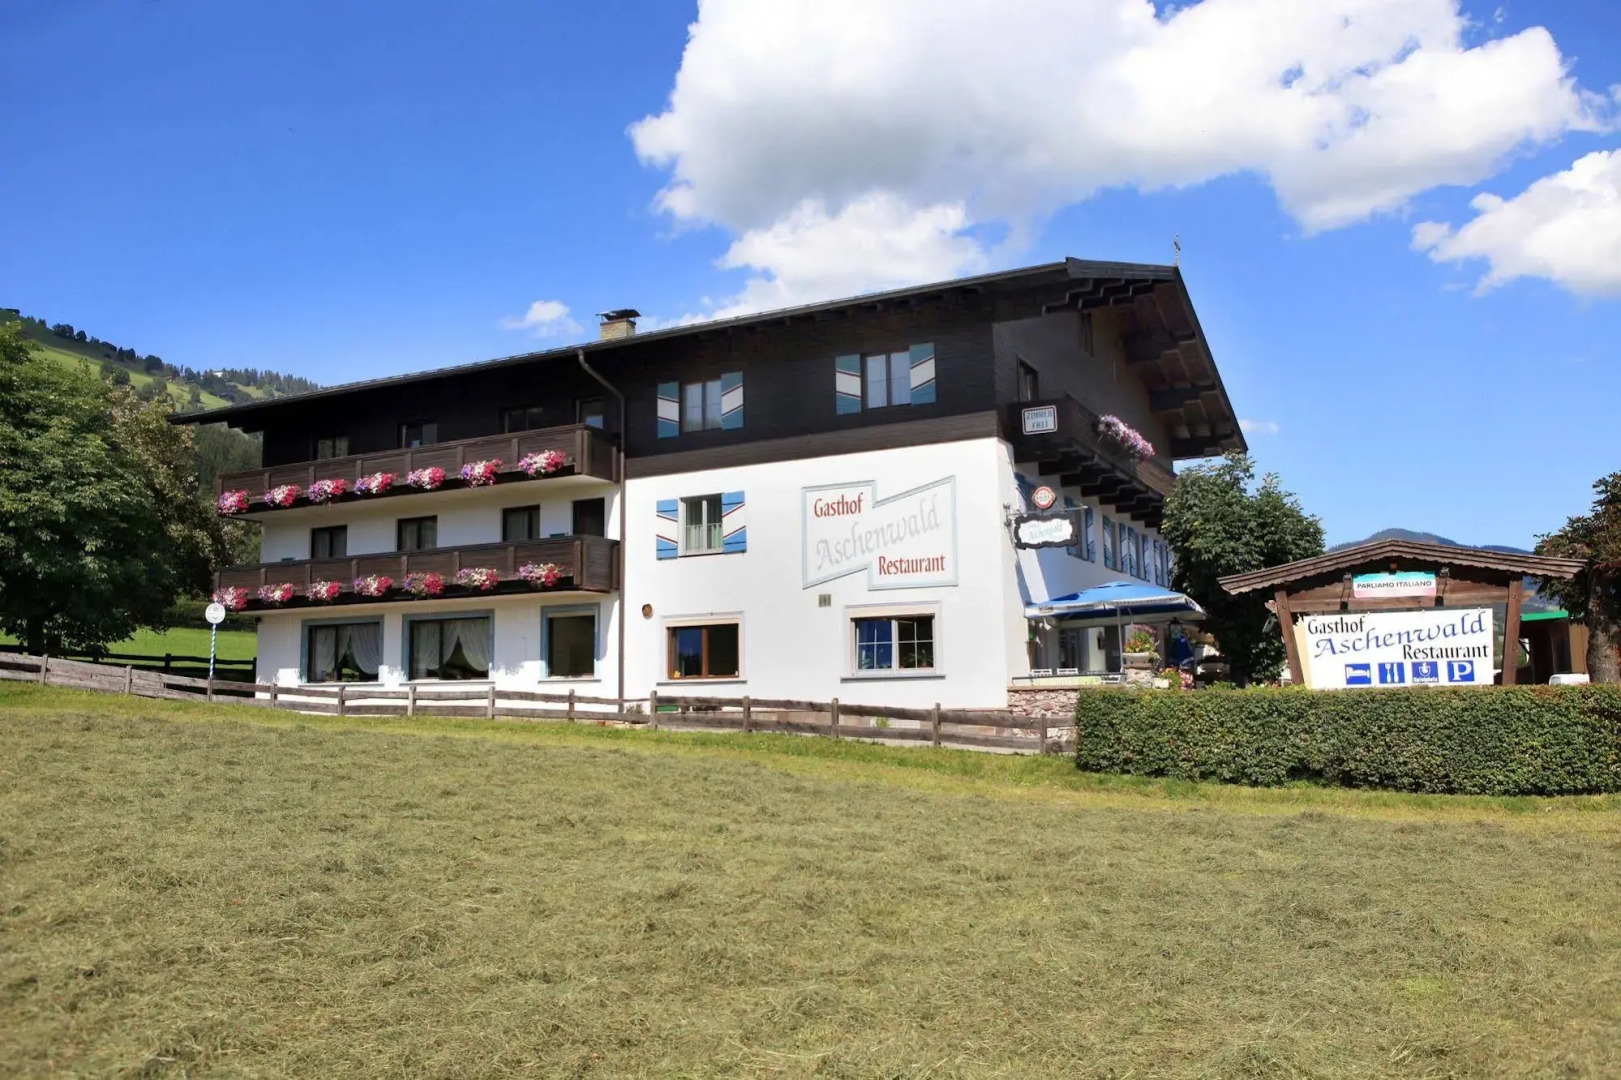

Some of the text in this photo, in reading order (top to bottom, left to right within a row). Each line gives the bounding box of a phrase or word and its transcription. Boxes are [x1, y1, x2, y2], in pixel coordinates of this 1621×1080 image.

[814, 492, 863, 518] Gasthof
[816, 493, 940, 570] Aschenwald
[878, 553, 946, 576] Restaurant
[1396, 580, 1432, 588] ITALIANO
[1308, 615, 1366, 635] Gasthof
[1314, 611, 1487, 659] Aschenwald
[1402, 644, 1490, 660] Restaurant
